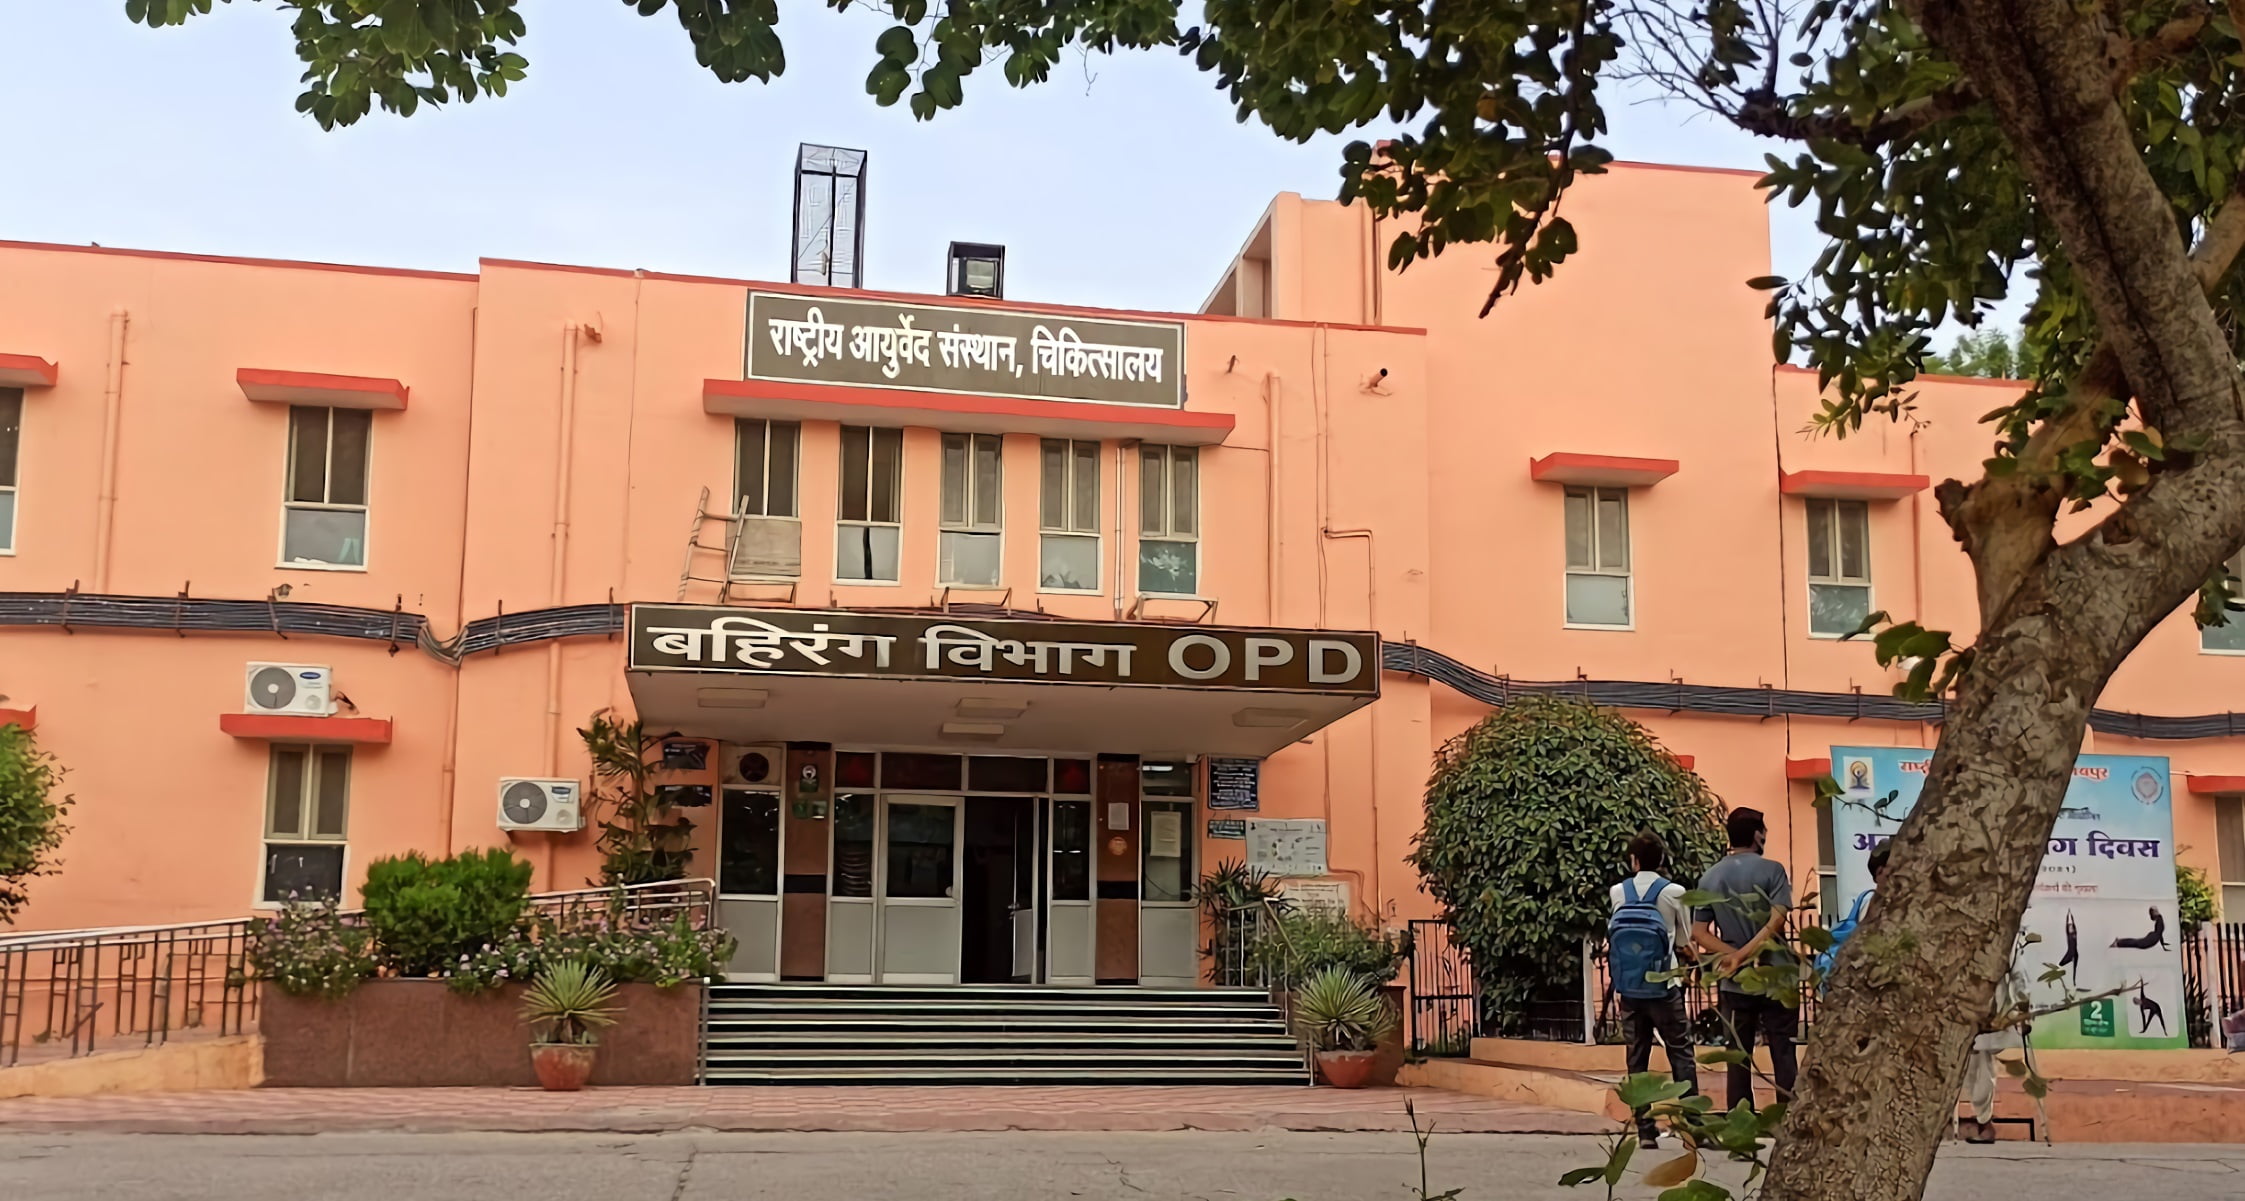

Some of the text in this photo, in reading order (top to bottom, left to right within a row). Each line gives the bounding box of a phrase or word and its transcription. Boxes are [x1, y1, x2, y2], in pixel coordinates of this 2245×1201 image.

[768, 306, 1163, 383] राष्ट्रीय आयुर्वेद संस्थान, चिकित्सालय
[646, 616, 1362, 684] बहिरंग विभाग OPD
[2086, 830, 2160, 859] दिवस
[2090, 1000, 2103, 1019] 2
